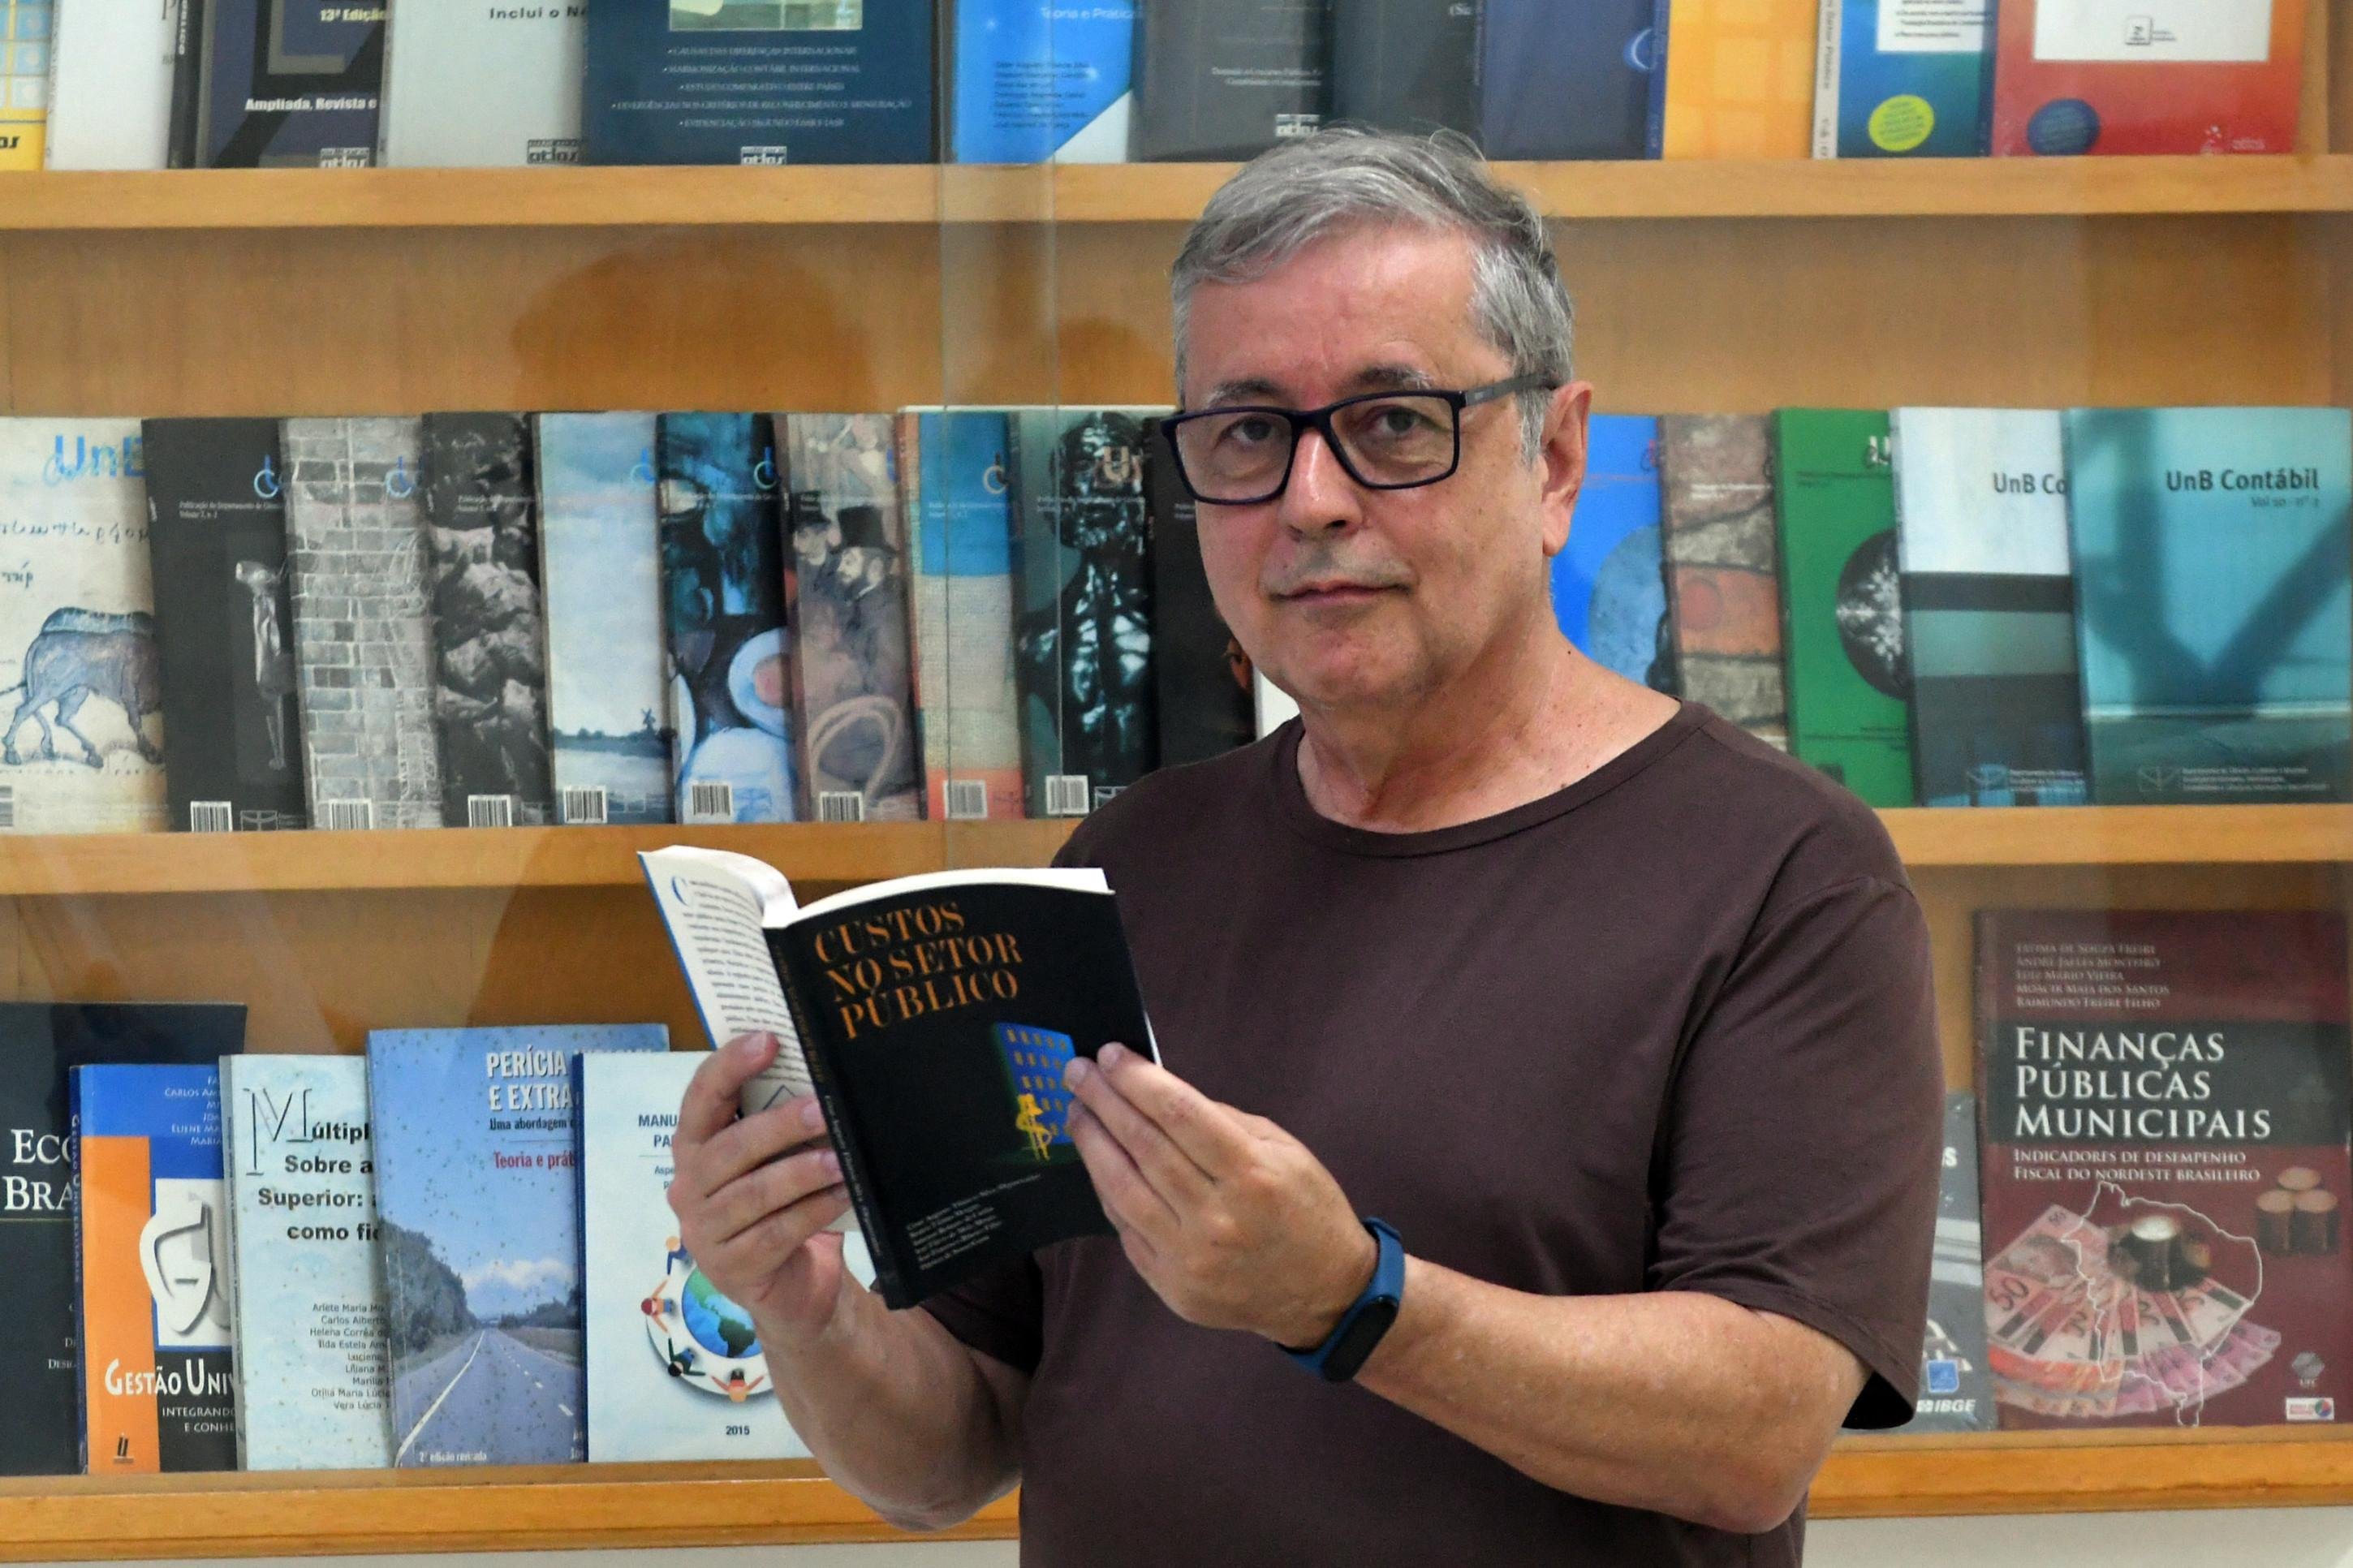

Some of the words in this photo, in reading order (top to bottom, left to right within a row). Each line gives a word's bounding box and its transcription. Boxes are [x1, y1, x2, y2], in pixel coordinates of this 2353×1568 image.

[489, 7, 542, 19] Inclui
[549, 9, 559, 18] o
[245, 98, 313, 112] Ampliada,
[316, 97, 366, 110] Revista
[368, 98, 377, 109] e
[1993, 472, 2036, 493] UnB
[2166, 469, 2213, 491] UnB
[2221, 468, 2321, 489] Contábil
[815, 902, 965, 963] CUSTOS
[826, 958, 882, 1003] NO
[888, 933, 1024, 980] SETOR
[839, 969, 1019, 1040] PÚBLICO
[2016, 997, 2081, 1007] RAIMUNDO
[2016, 1027, 2226, 1069] FINANÇAS
[487, 1045, 569, 1078] PERÍCIA
[2016, 1062, 2212, 1100] PÚBLICAS
[165, 1088, 200, 1097] CARLOS
[489, 1084, 502, 1111] E
[508, 1083, 574, 1110] EXTRA
[489, 1118, 511, 1131] Uma
[514, 1119, 567, 1131] abordagem
[638, 1114, 678, 1127] MANU
[2015, 1105, 2272, 1138] MUNICIPAIS
[653, 1135, 673, 1148] PA
[493, 1152, 532, 1169] Teoria
[536, 1155, 544, 1167] e
[548, 1150, 575, 1170] prát
[2013, 1148, 2117, 1163] INDICADORES
[2121, 1151, 2140, 1163] DE
[2145, 1151, 2247, 1164] DESEMPENHO
[285, 1155, 352, 1174] Sobre
[654, 1165, 675, 1176] Aspe
[2013, 1166, 2062, 1180] FISCAL
[2067, 1168, 2091, 1180] DO
[2095, 1168, 2172, 1181] NORDESTE
[2177, 1168, 2260, 1182] BRASILEIRO
[258, 1188, 364, 1210] Superior:
[287, 1227, 349, 1240] como
[312, 1303, 339, 1312] Arlete
[321, 1315, 349, 1325] Carlos
[352, 1316, 386, 1325] Alberto
[310, 1328, 341, 1337] Helena
[339, 1340, 367, 1348] Estela
[104, 1358, 182, 1396] GESTÃO
[338, 1389, 363, 1397] Maria
[1933, 1399, 1976, 1412] IBGE
[184, 1423, 190, 1432] E
[193, 1422, 234, 1432] CONHE
[725, 1426, 751, 1436] 2015
